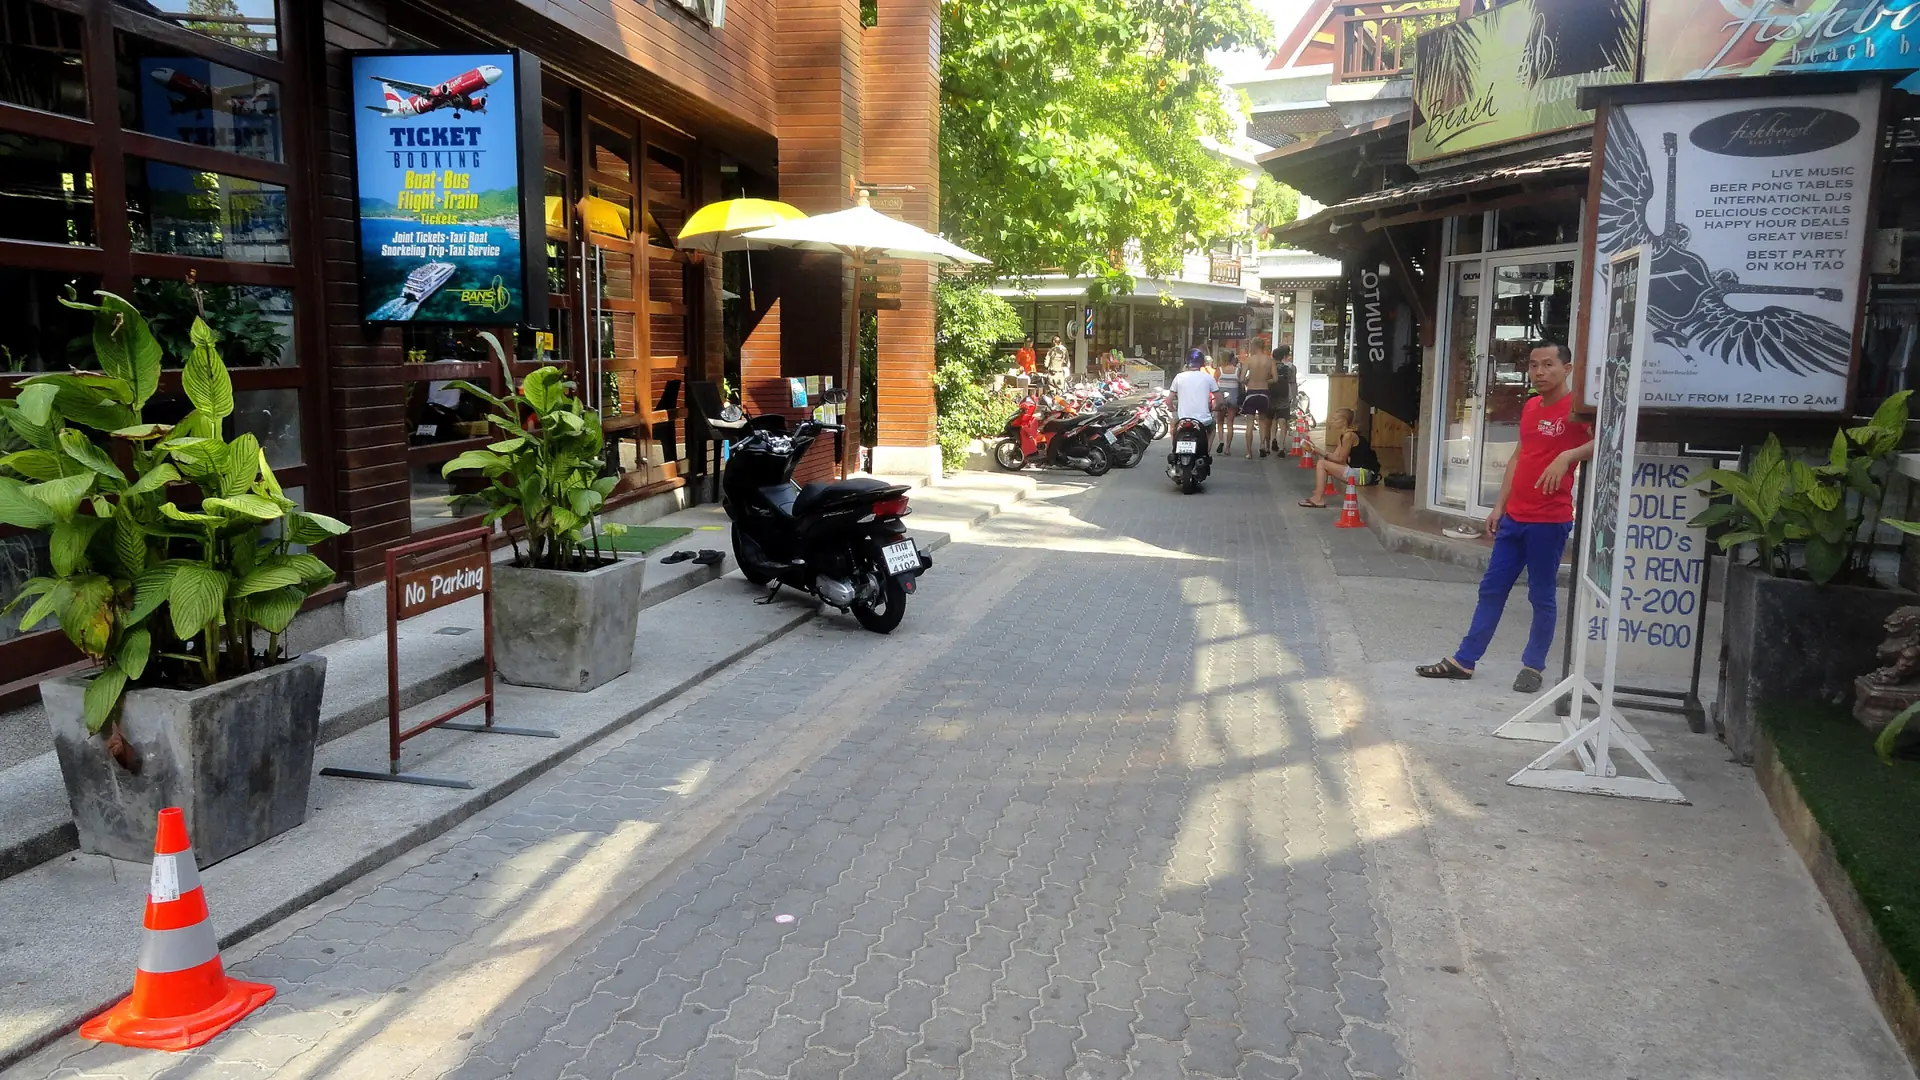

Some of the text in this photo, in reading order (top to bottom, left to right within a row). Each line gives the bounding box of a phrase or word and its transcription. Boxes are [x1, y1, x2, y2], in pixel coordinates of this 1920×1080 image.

[1791, 37, 1875, 64] beach
[1425, 82, 1499, 143] Beach
[390, 127, 481, 146] TICKET
[394, 152, 480, 168] BOOKING
[1772, 166, 1855, 178] LIVE MUSIC
[1710, 179, 1853, 192] BEER PONG TABLES
[1713, 192, 1852, 205] INTERNATIONL DJS
[1695, 205, 1851, 218] DELICIOUS COCKTAILS
[421, 214, 458, 225] Tickets
[1704, 217, 1849, 229] HAPPY HOUR DEALS
[392, 231, 414, 243] Joint
[469, 231, 488, 243] Boat
[1747, 230, 1848, 241] GREAT VIBES!
[381, 244, 426, 258] Snorkeling
[468, 244, 500, 256] Service
[1746, 249, 1846, 259] BEST PARTY
[1745, 260, 1844, 271] ON KOH TAO
[1213, 321, 1234, 330] ATM
[1644, 393, 1838, 405] DAILY FROM 12PM TO 2AM
[893, 560, 916, 571] 4102
[1645, 557, 1704, 584] RENT
[405, 566, 484, 607] No Parking
